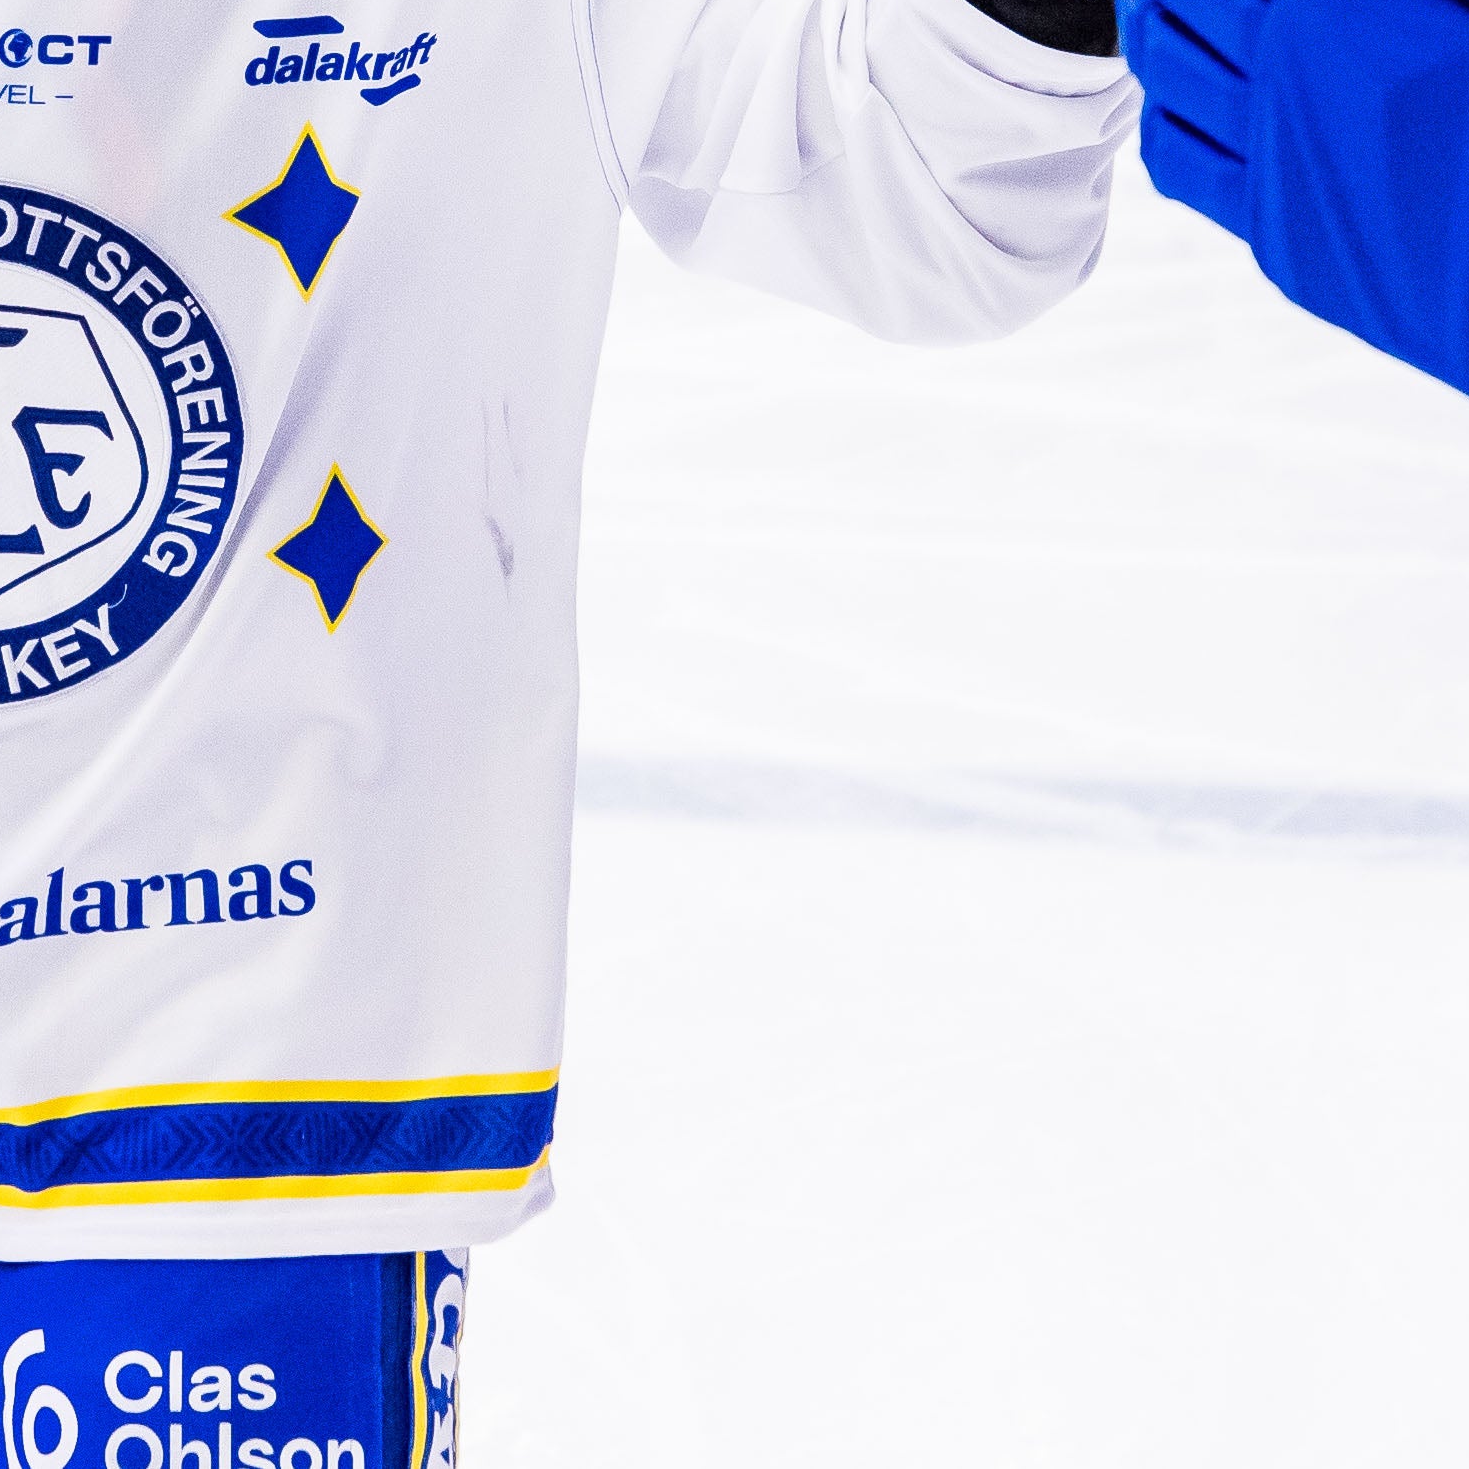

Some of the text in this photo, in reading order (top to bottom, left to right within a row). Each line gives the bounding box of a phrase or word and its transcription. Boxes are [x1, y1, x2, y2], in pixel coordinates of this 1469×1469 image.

[244, 32, 438, 86] dalakraft
[103, 1349, 277, 1414] Clas
[103, 1421, 366, 1469] Ohlson
